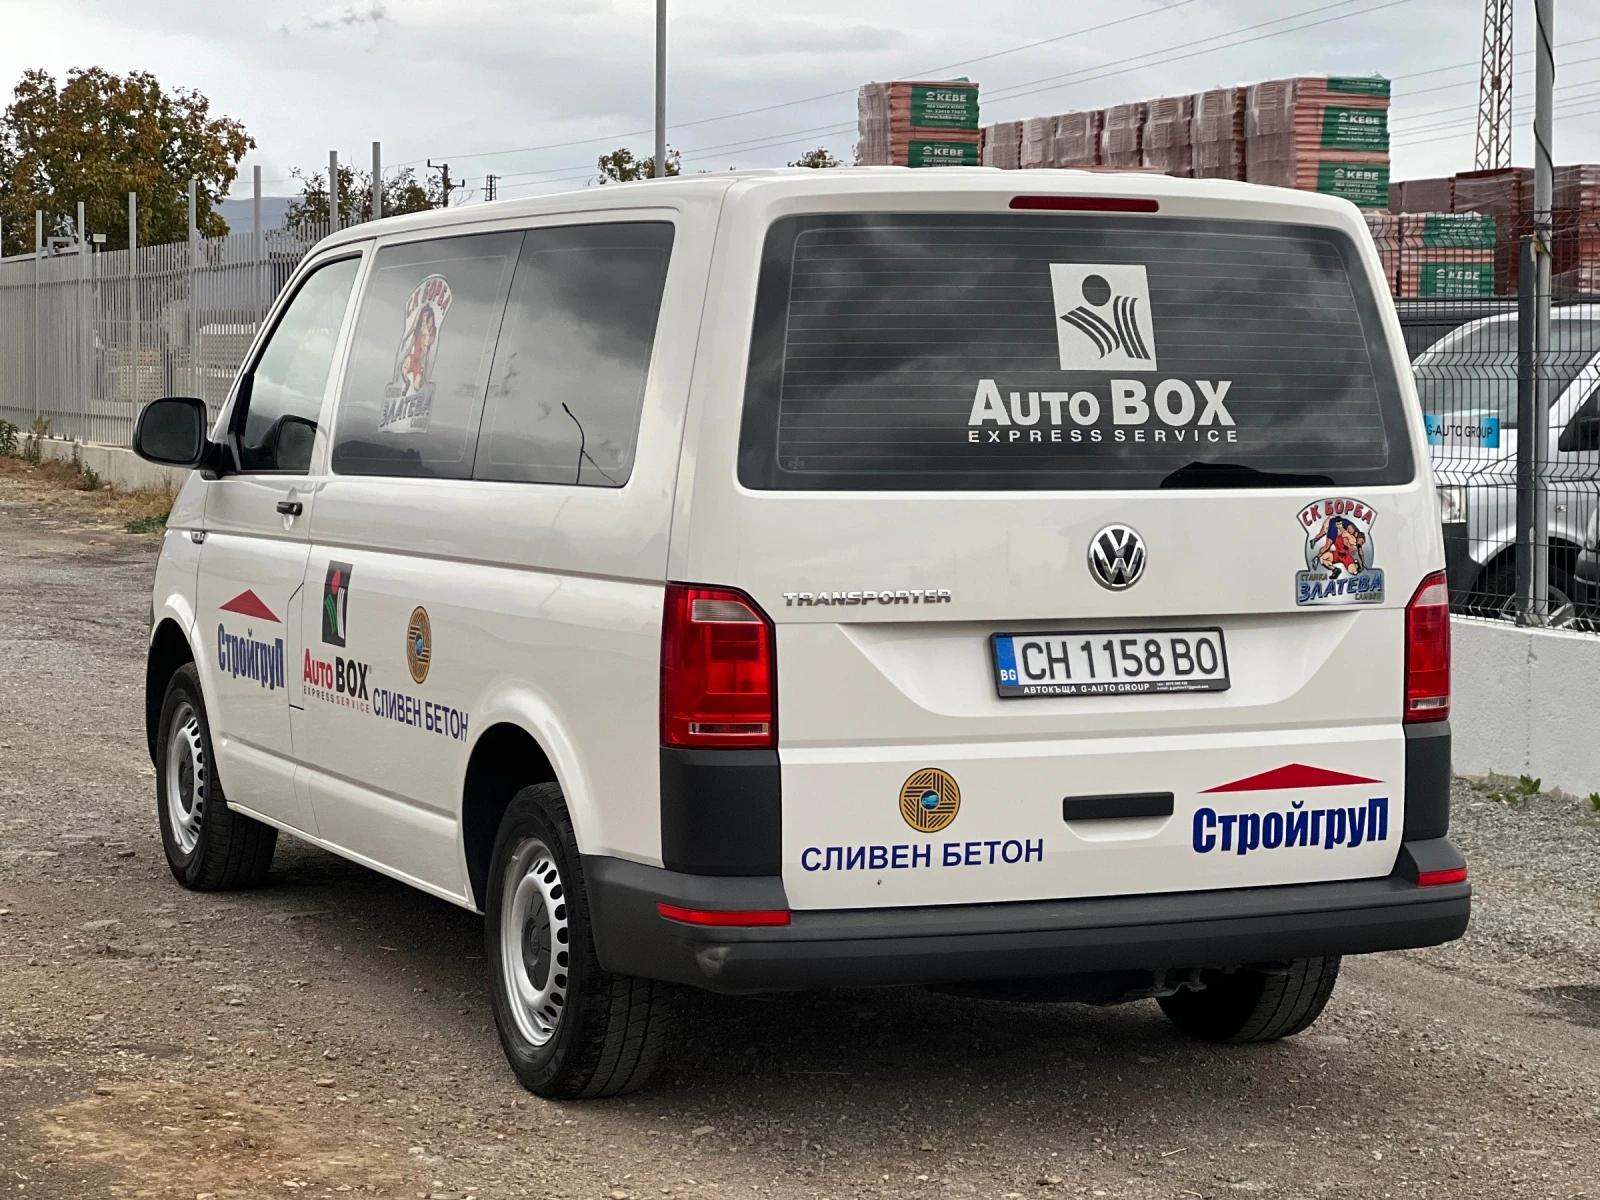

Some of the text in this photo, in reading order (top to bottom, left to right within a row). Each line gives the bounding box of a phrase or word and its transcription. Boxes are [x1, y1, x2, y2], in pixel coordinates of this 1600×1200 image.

[936, 93, 967, 102] KEBE
[1349, 115, 1380, 124] KEBE
[934, 148, 964, 156] KEBE
[1346, 171, 1379, 180] KEBE
[421, 279, 451, 316] БОРБА
[1110, 379, 1236, 426] BOX
[968, 429, 1237, 443] EXPRESS SERVICE
[1426, 424, 1493, 438] G-AUTO GROUP
[1302, 499, 1373, 527] СК БОРБА
[1299, 571, 1382, 602] ЗЛАТЕВА
[782, 588, 952, 607] TRANSPORTER
[1080, 638, 1166, 679] 1158
[1000, 669, 1017, 682] BG
[1023, 684, 1077, 695] АВТОКЪЩА
[1081, 683, 1116, 693] G-AUTO
[1118, 683, 1150, 692] GROUP
[303, 685, 370, 714] EXPRESS SERVICE
[373, 687, 469, 743] СЛИВЕН БЕТОН
[801, 838, 1044, 872] СЛИВЕН БЕТОН
